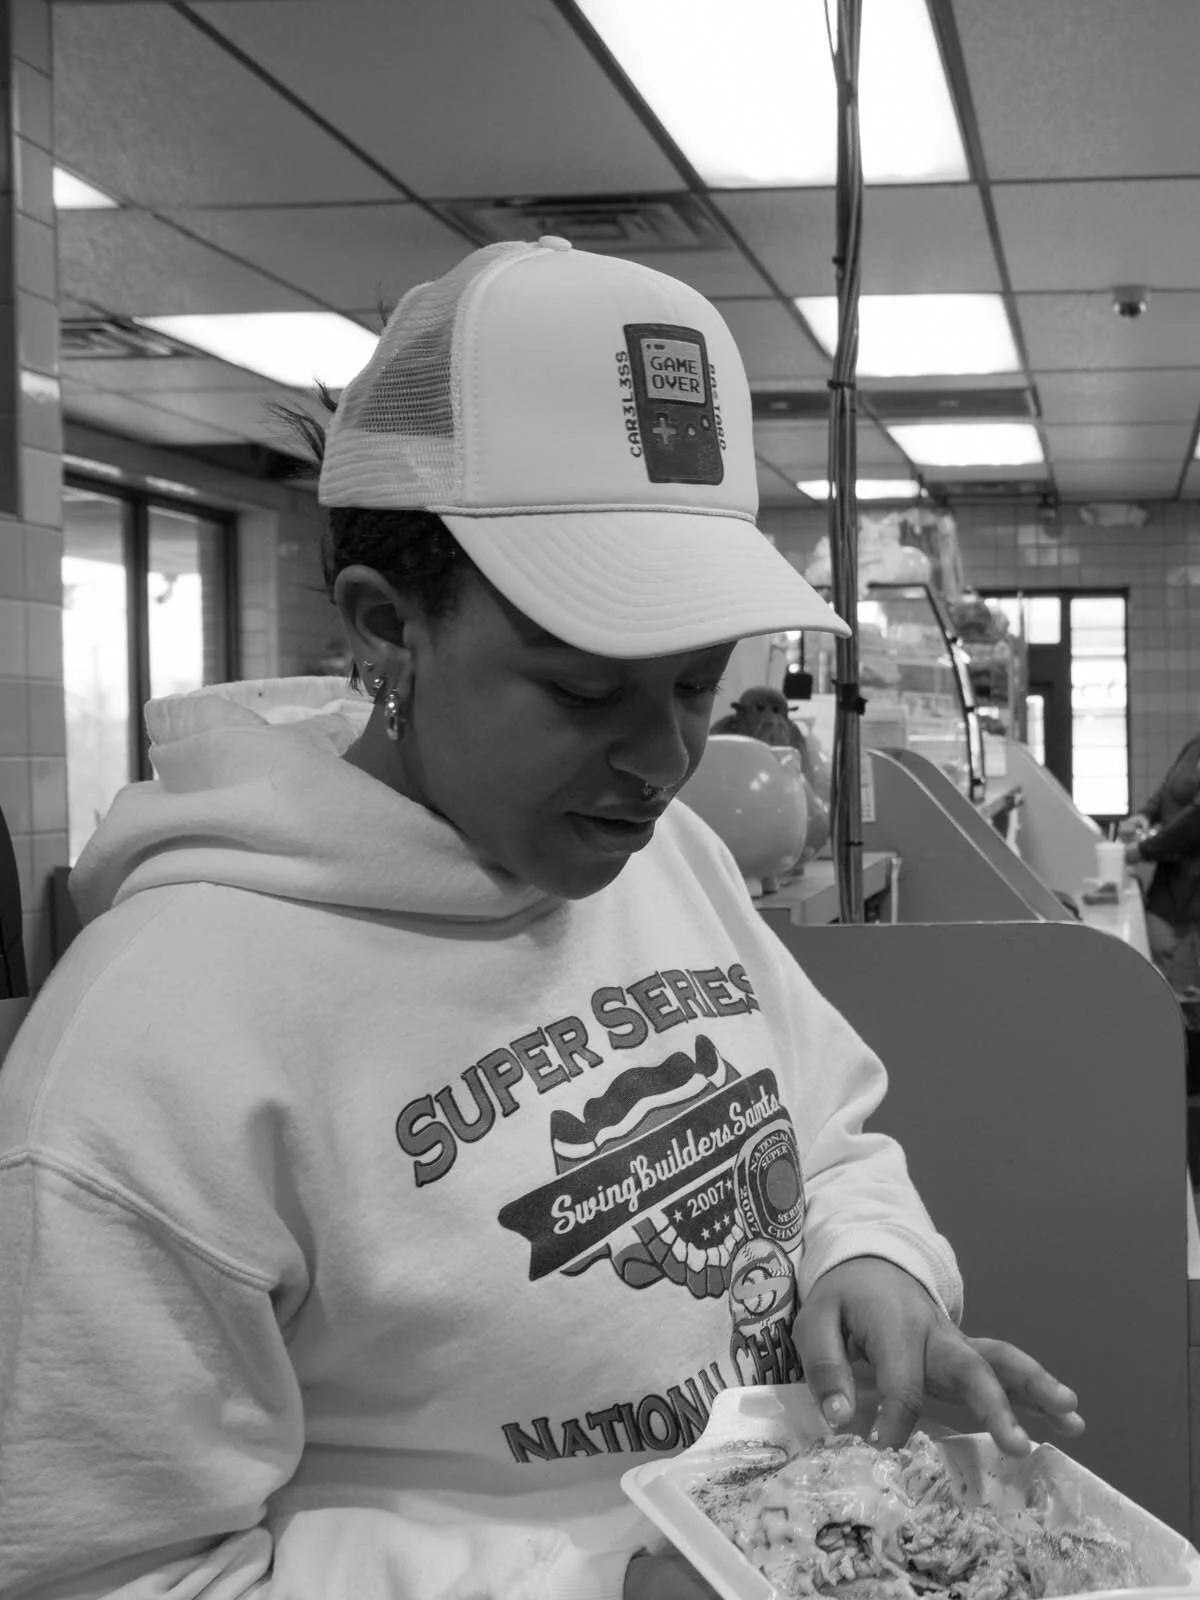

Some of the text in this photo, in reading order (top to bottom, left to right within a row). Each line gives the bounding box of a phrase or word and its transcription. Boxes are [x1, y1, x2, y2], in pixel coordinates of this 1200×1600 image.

[650, 356, 698, 375] GAME
[652, 374, 700, 393] OVER
[395, 1015, 604, 1188] SUPER
[687, 1180, 725, 1218] 2007
[501, 1361, 727, 1463] NATION
